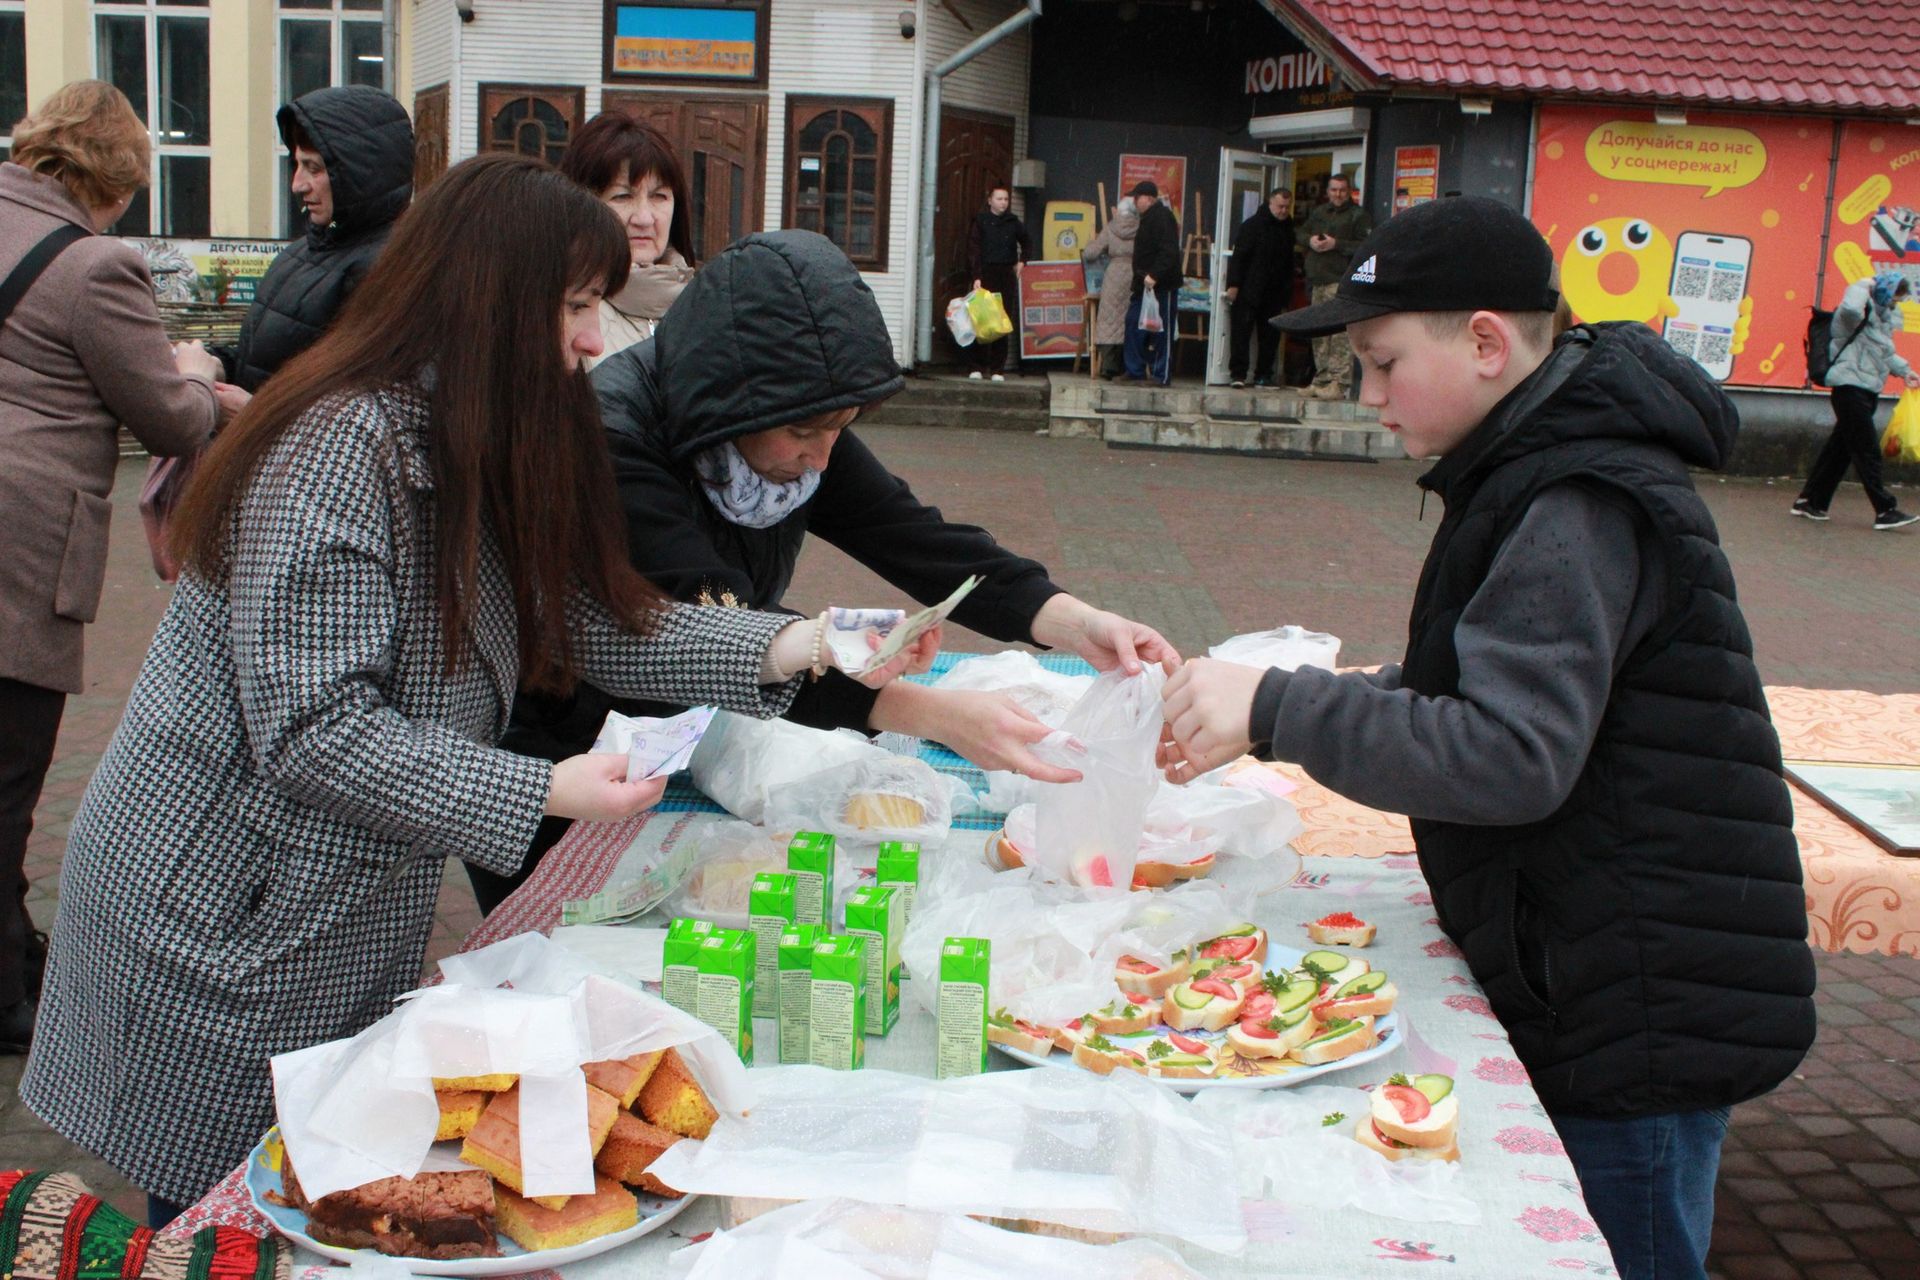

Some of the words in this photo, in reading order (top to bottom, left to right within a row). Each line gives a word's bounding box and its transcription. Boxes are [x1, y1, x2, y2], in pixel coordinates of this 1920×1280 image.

[1245, 52, 1333, 94] КОПІЙ
[1599, 130, 1693, 150] Долучайся
[1697, 141, 1719, 153] до
[1724, 142, 1753, 155] нас
[1611, 155, 1621, 169] у
[1625, 155, 1738, 175] соцмережах!
[1351, 272, 1376, 283] adidas
